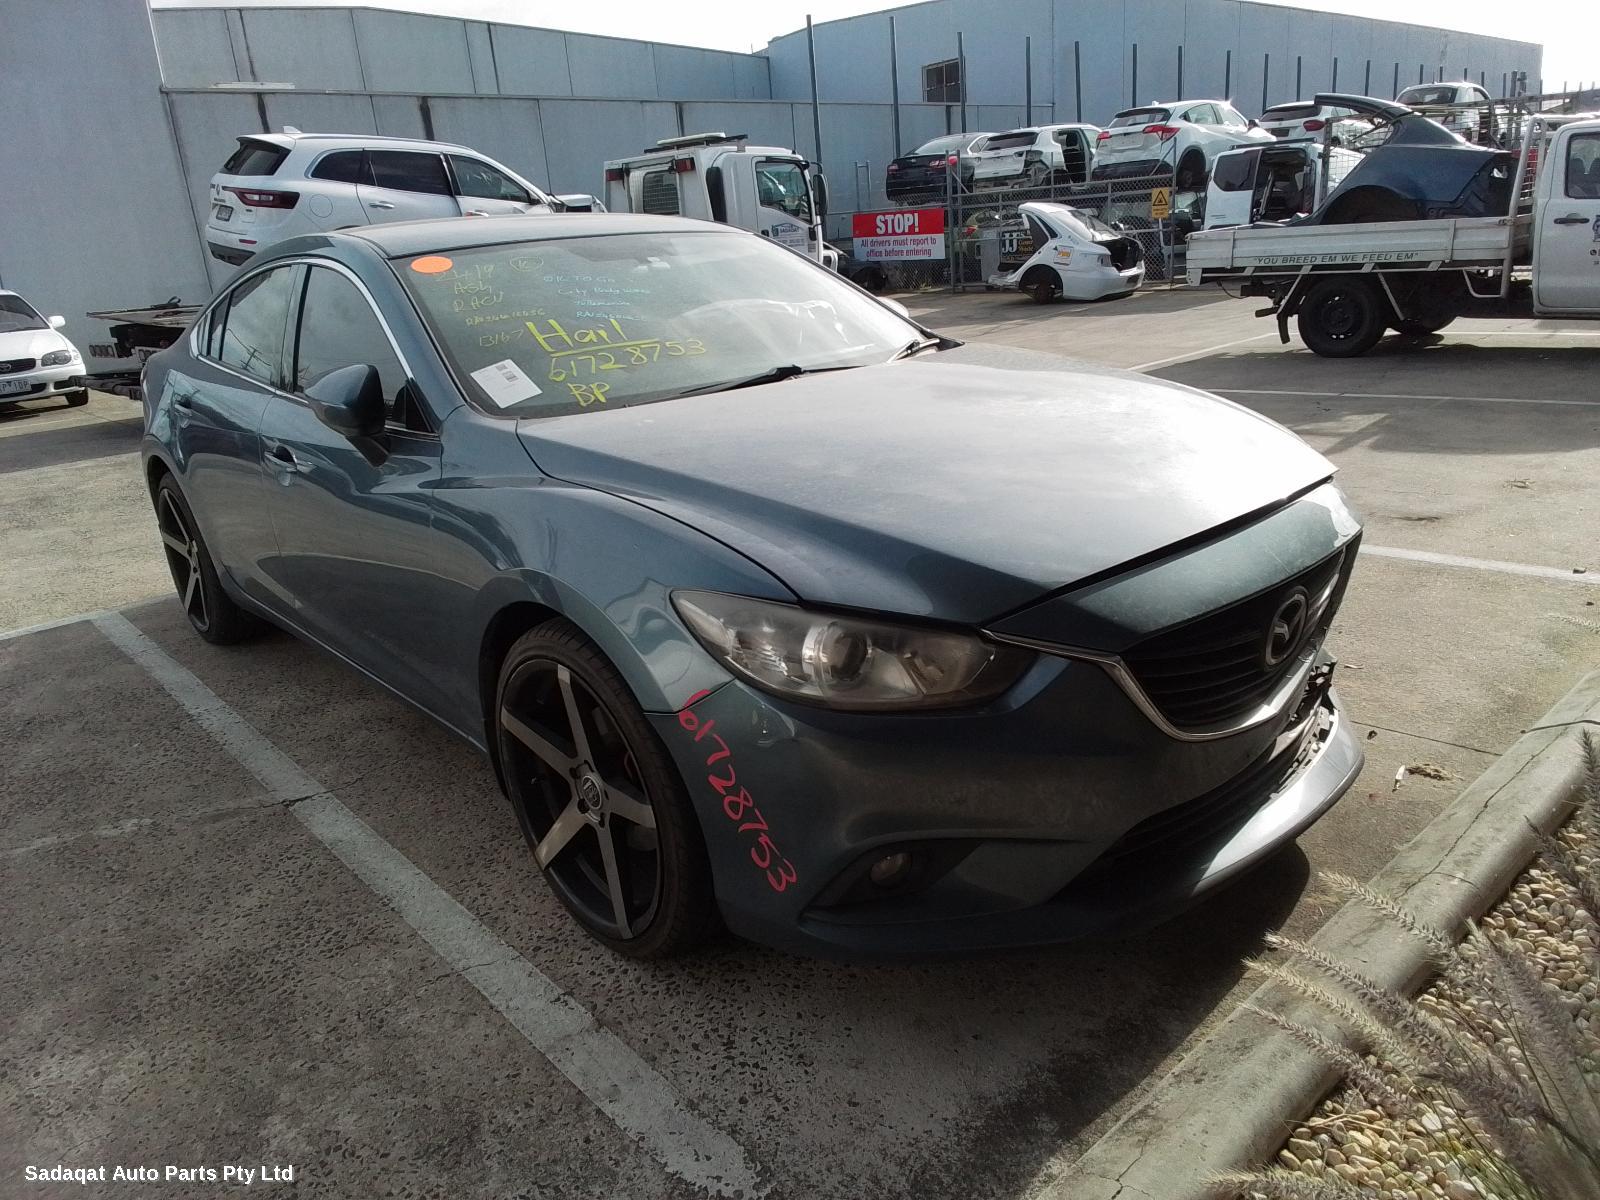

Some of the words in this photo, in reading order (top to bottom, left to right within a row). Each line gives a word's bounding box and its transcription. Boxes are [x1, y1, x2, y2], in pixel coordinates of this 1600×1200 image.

[876, 213, 919, 235] STOP!
[861, 239, 869, 248] All
[870, 239, 891, 247] drivers
[893, 237, 908, 246] must
[910, 237, 929, 247] report
[931, 236, 937, 245] to
[866, 249, 883, 258] office
[884, 248, 904, 257] before
[906, 247, 932, 257] entering
[1282, 256, 1317, 264] BREED
[1321, 255, 1338, 263] EM
[1341, 254, 1356, 262] WE
[1362, 253, 1393, 261] FEED
[525, 319, 629, 352] Hail
[549, 338, 706, 382] 61728753
[567, 382, 610, 407] BP
[678, 689, 798, 892] 61728753
